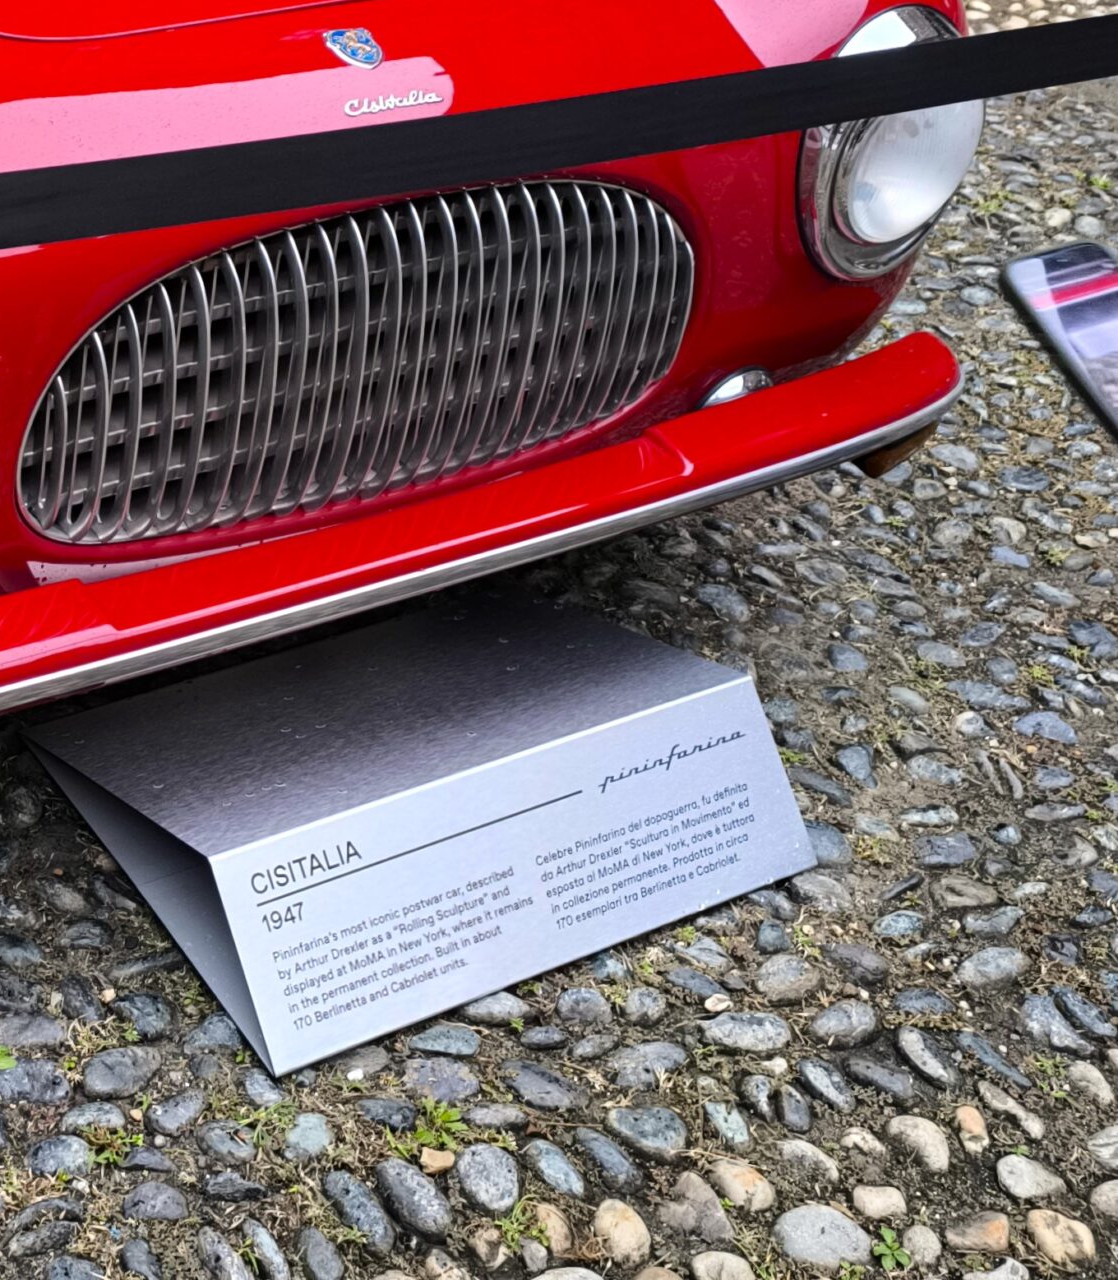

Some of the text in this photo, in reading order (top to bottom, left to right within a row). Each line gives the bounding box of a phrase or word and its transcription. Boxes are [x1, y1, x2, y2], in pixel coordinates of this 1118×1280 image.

[344, 90, 442, 116] Cisitalia
[598, 730, 746, 794] pininfarina
[535, 783, 748, 866] Celebre Pininfarina del dopoguerra, fu definita
[540, 871, 553, 882] da
[556, 859, 587, 877] Arthur
[589, 845, 623, 865] Drexler
[671, 825, 679, 835] in
[738, 797, 750, 809] ed
[546, 813, 755, 898] esposta al MoMA di New York, dove è tuttora
[250, 840, 362, 895] CISITALIA
[551, 833, 749, 914] in collezione permanente. Prodotta in circa
[556, 853, 741, 930] 170 esemplari tra Berlinetta e Cabriolet.
[261, 901, 304, 933] 1947
[272, 866, 514, 963] Pininfarina's most iconic postwar car, described
[277, 968, 291, 980] by
[295, 954, 328, 974] Arthur
[331, 939, 368, 960] Drexler
[371, 933, 383, 945] as
[385, 931, 392, 940] a
[491, 885, 510, 901] and
[283, 896, 534, 997] displayed at MoMA in New York, where it remains
[288, 925, 502, 1013] in the permanent collection. Built in about
[293, 958, 469, 1030] 170 Berlinetta and Cabriolet units.
